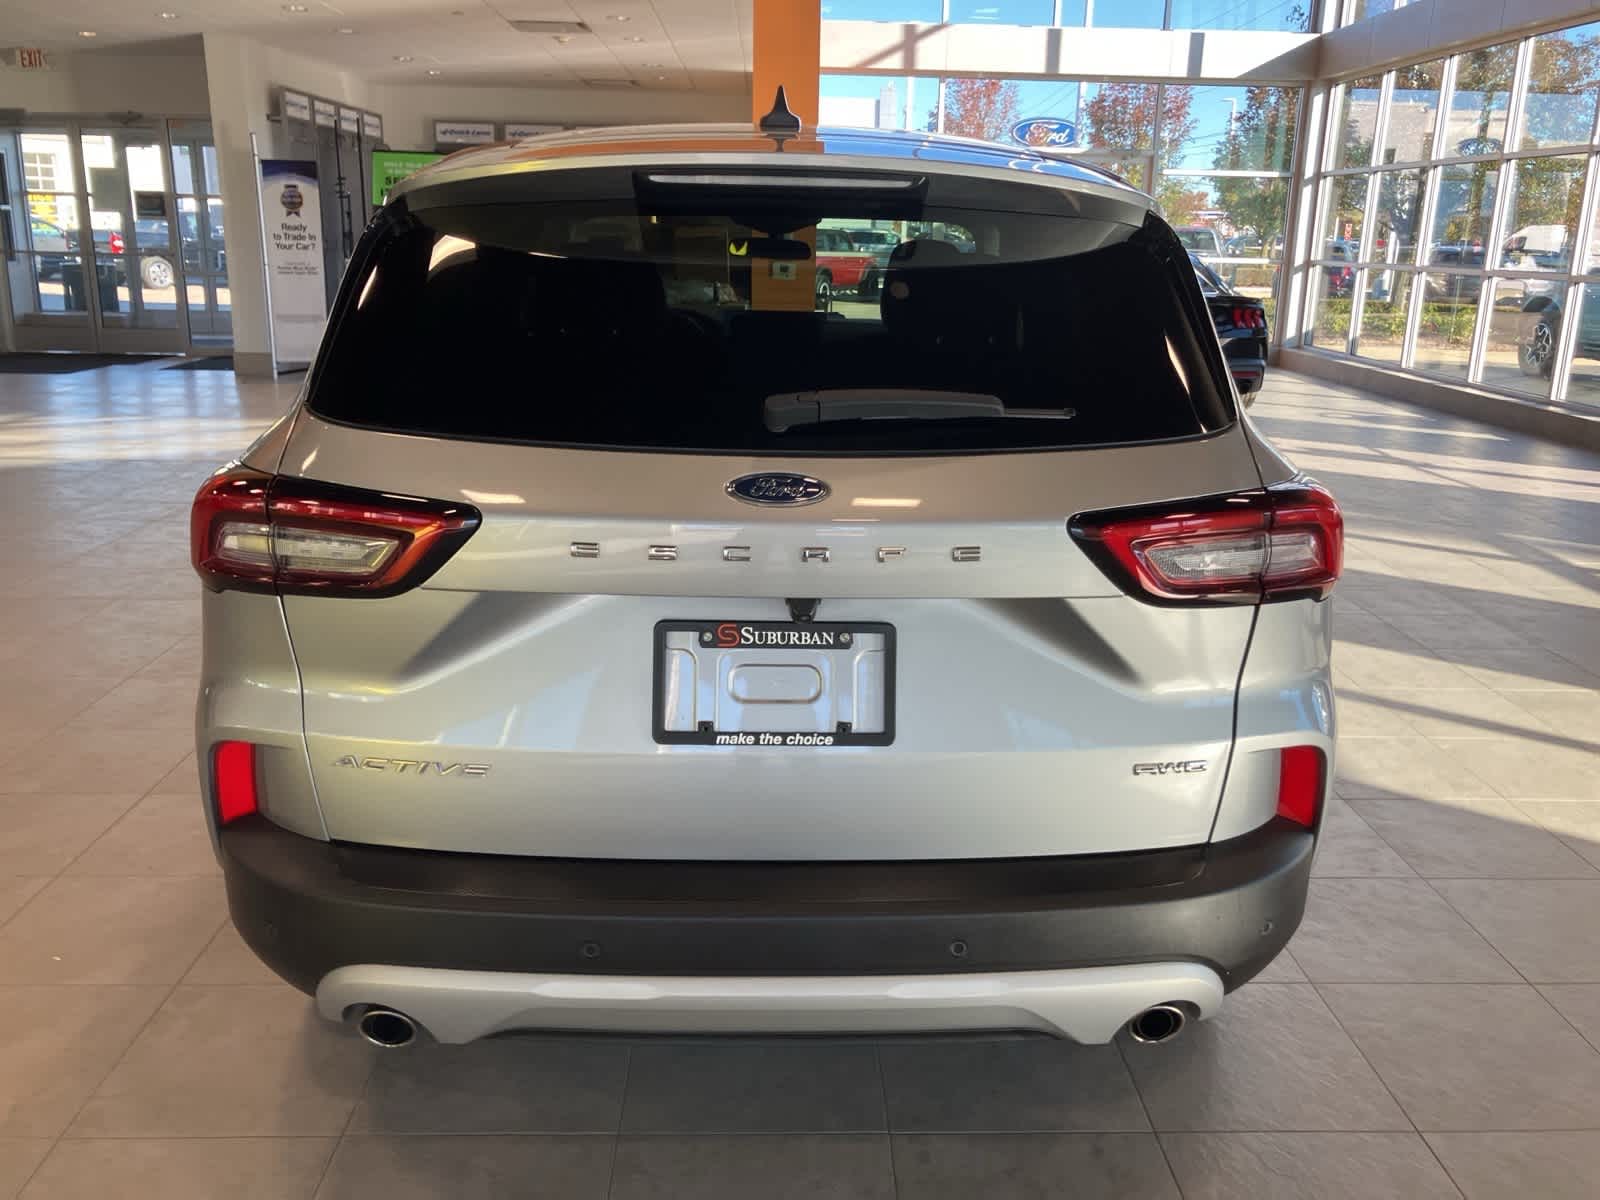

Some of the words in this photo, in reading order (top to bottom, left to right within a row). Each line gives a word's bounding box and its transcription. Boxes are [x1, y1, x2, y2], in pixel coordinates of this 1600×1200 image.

[20, 48, 42, 68] EXIT
[273, 232, 282, 241] to
[284, 232, 307, 241] Trade
[308, 233, 317, 241] In
[281, 223, 308, 233] Ready
[275, 242, 294, 250] Your
[296, 242, 316, 250] Car?
[750, 478, 807, 497] Ford
[570, 541, 982, 562] ESCAPE
[741, 626, 834, 645] SUBURBAN
[716, 734, 755, 745] make
[759, 733, 782, 745] the
[786, 733, 834, 746] choice
[334, 754, 491, 778] ACTIVE
